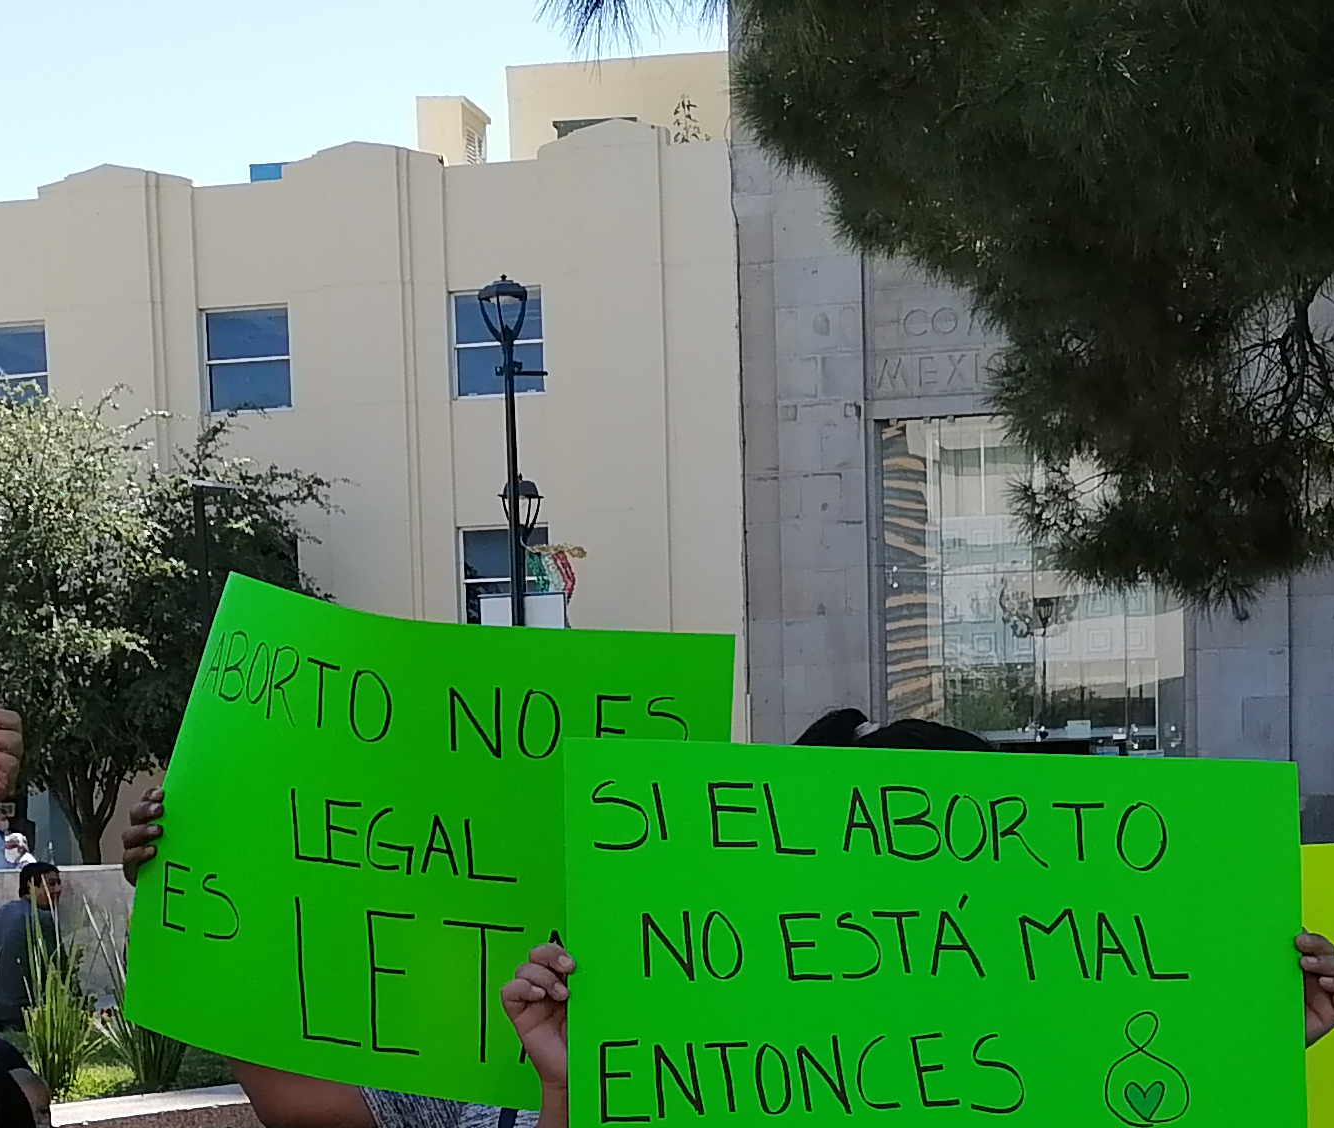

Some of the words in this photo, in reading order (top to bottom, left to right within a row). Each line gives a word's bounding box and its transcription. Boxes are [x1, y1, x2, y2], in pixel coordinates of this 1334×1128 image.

[202, 630, 393, 743] ABORTO
[448, 686, 561, 759] NO
[595, 694, 688, 741] ES
[290, 788, 518, 884] LEGAL
[591, 780, 668, 851] SI
[707, 781, 817, 856] EL
[842, 785, 1168, 872] ABORTO
[162, 860, 239, 941] ES
[294, 896, 564, 1066] LET
[641, 910, 743, 982] NO
[778, 893, 986, 982] ESTÁ
[1018, 908, 1190, 982] MAL
[599, 1032, 1025, 1124] ENTONCES
